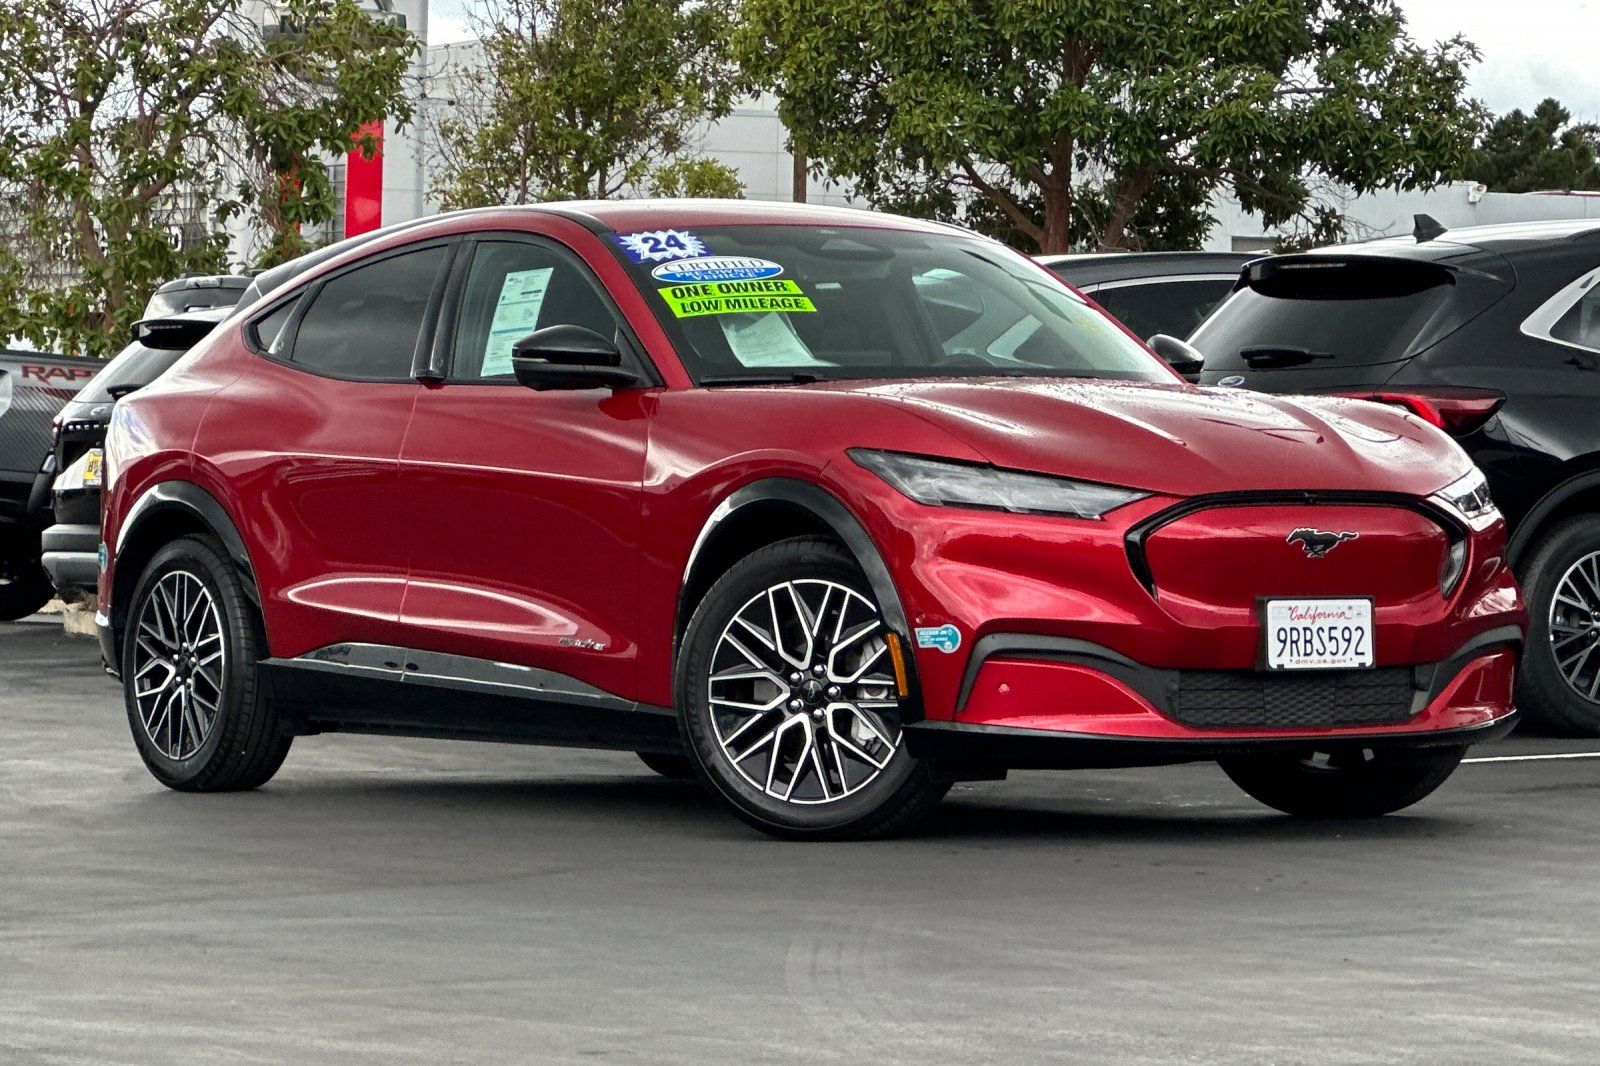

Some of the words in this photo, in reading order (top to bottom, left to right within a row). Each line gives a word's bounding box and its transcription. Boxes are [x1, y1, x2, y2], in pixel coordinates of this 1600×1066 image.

[641, 234, 687, 253] 24
[664, 260, 765, 272] CERTIFIED
[671, 285, 713, 299] ONE
[717, 281, 787, 295] OWNER
[680, 301, 719, 314] LOW
[725, 297, 805, 311] MILEAGE
[21, 364, 97, 386] RAP
[1288, 605, 1352, 625] California
[1277, 626, 1365, 657] 9RBS592
